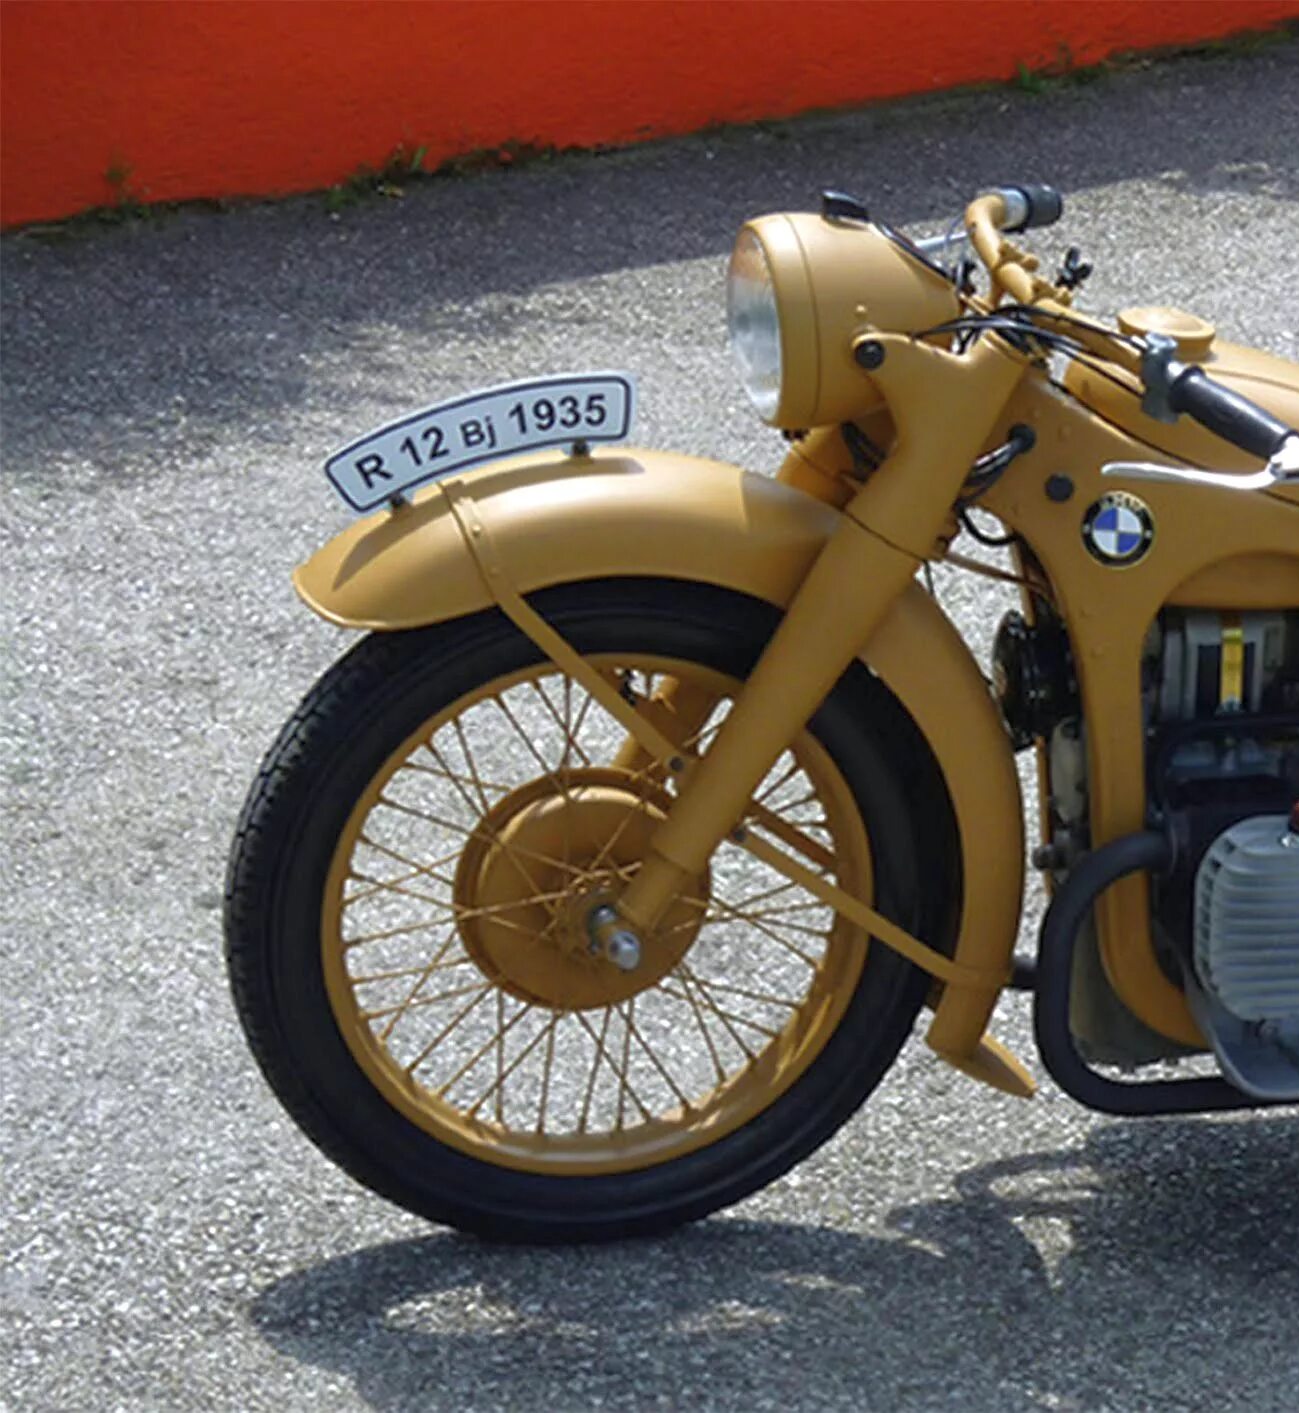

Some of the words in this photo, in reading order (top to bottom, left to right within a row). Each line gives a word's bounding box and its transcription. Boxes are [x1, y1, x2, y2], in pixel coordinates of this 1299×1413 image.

[354, 453, 393, 489] R
[400, 426, 450, 466] 12
[459, 416, 497, 449] Bj
[508, 394, 607, 434] 1935
